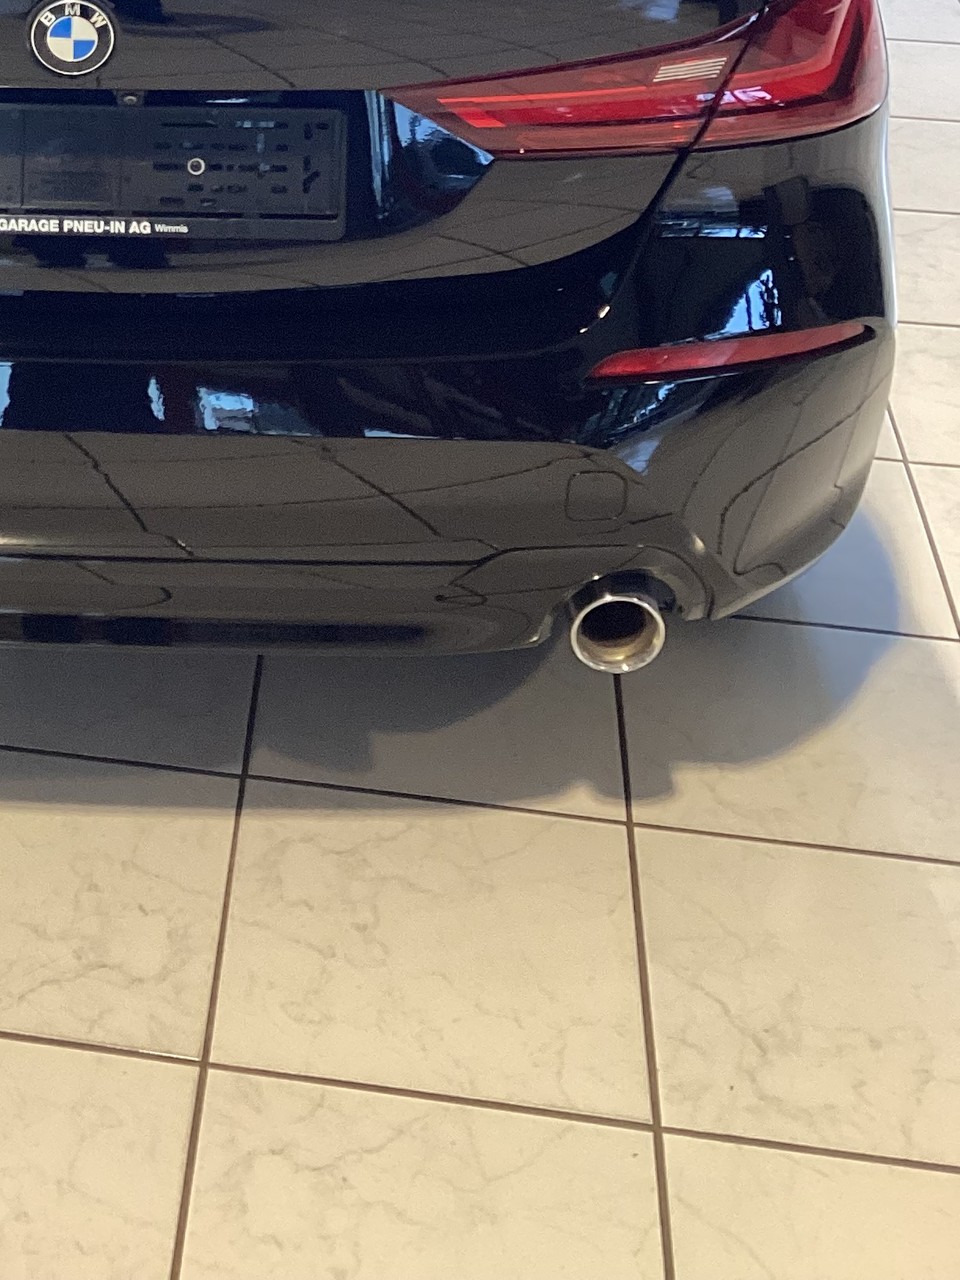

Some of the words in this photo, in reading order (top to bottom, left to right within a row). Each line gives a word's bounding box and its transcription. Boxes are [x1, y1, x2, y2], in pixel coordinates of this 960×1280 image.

[40, 2, 107, 28] BMW
[63, 219, 126, 234] PNEU-IN
[128, 221, 152, 235] AG
[154, 223, 189, 234] Wimmis
